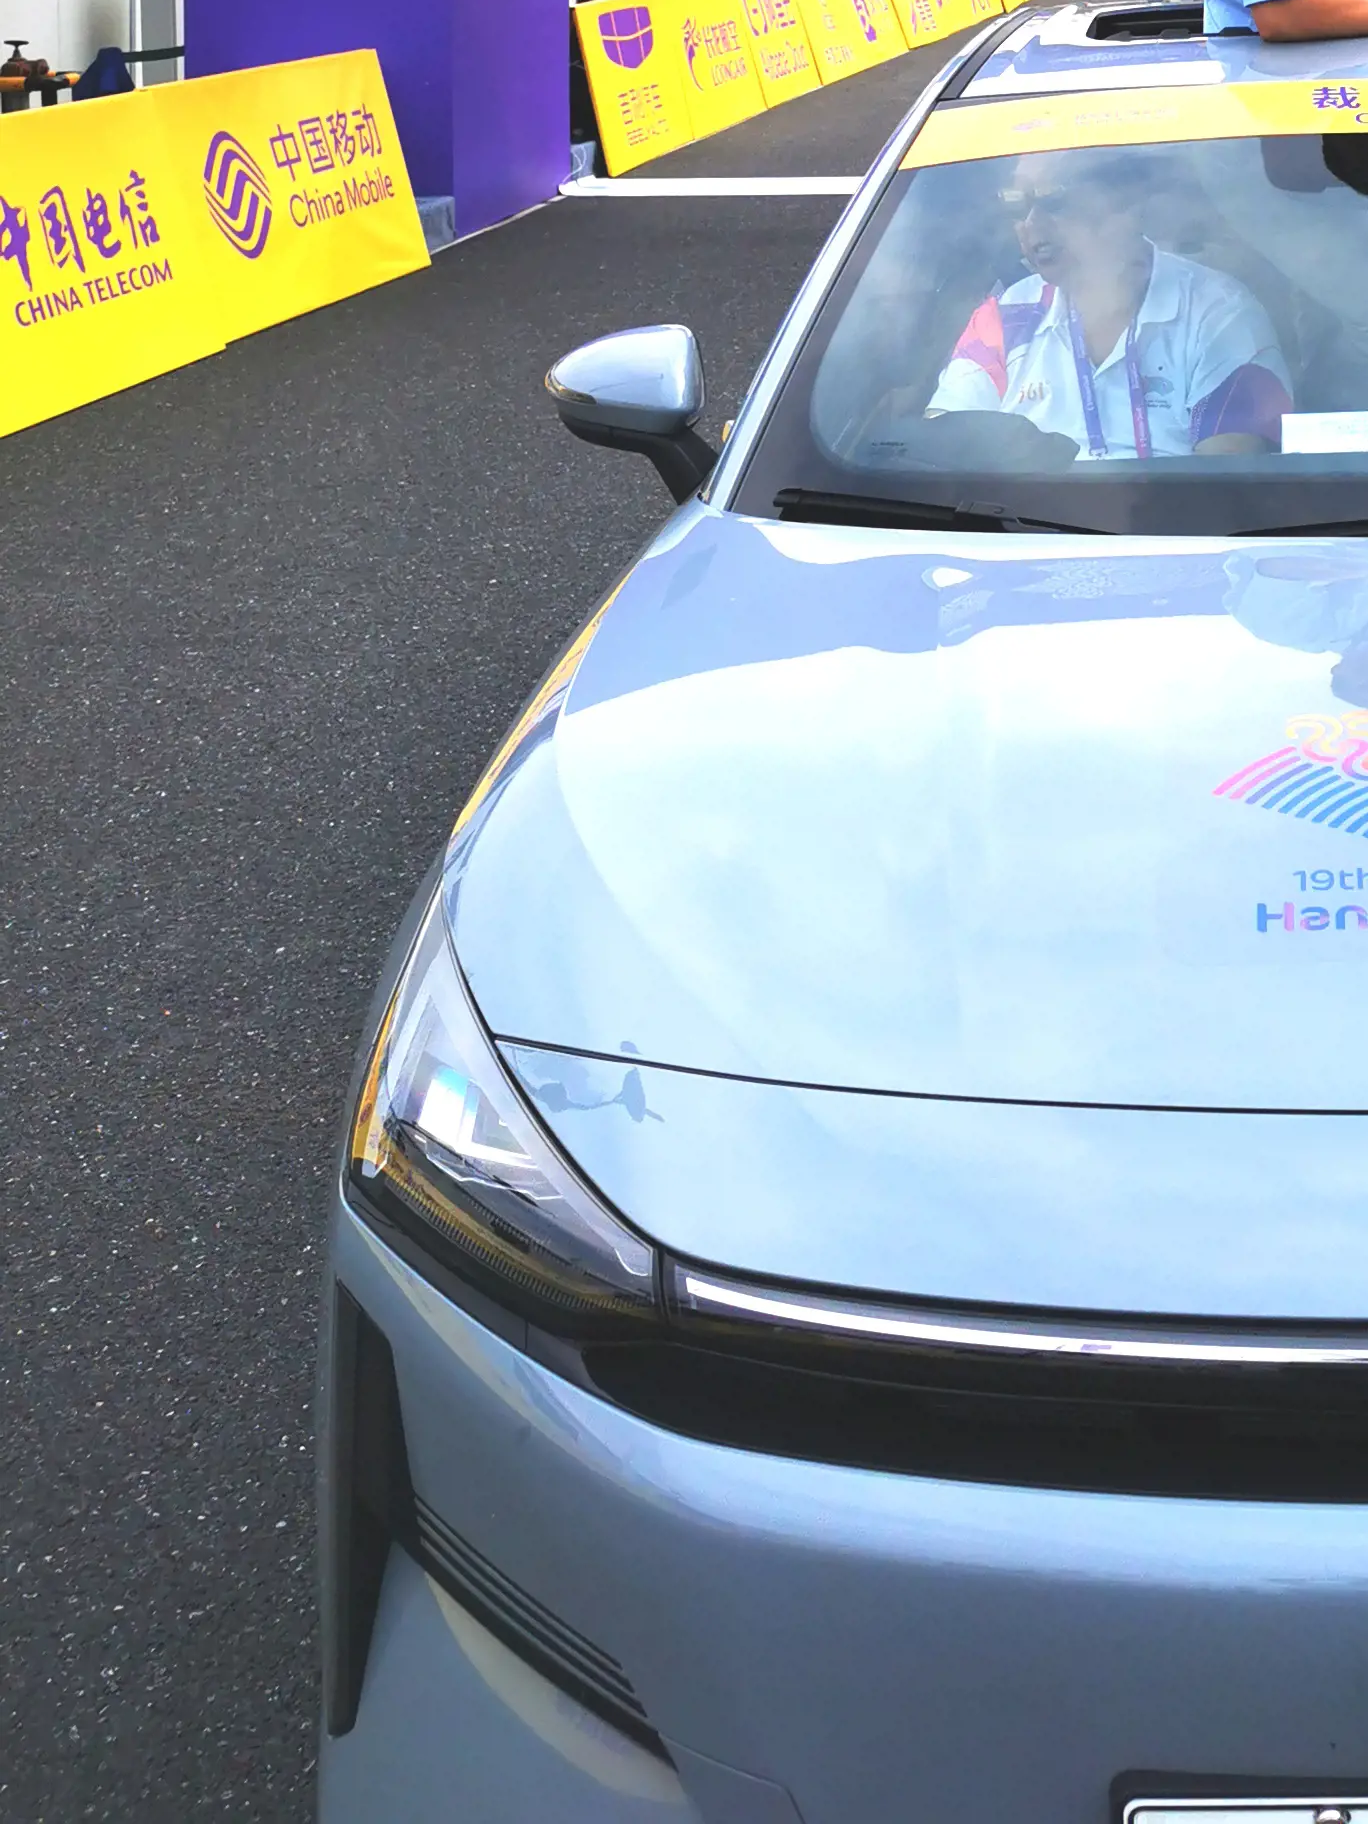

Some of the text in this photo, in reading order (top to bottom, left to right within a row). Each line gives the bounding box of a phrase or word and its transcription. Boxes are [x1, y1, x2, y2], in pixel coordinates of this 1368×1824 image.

[269, 103, 384, 182] 中国移动
[289, 172, 396, 229] China Mobile
[14, 258, 174, 327] CHINA TELECOM
